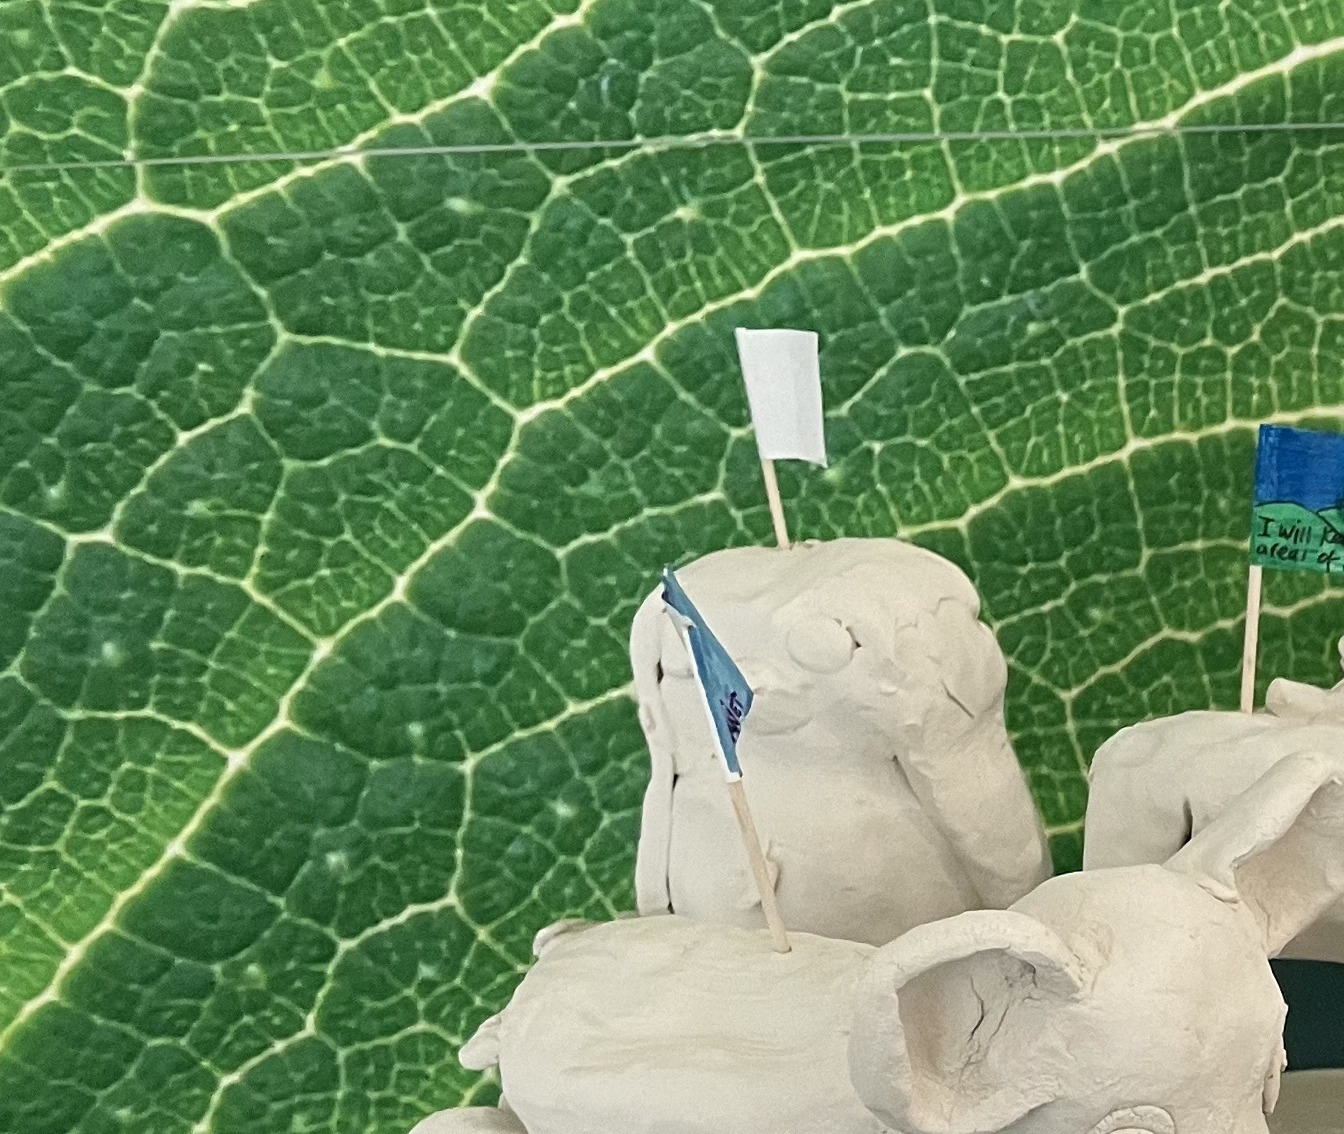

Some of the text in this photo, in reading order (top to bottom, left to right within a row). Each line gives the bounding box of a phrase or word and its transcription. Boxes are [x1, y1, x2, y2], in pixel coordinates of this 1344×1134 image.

[1257, 516, 1275, 537] I
[1278, 520, 1312, 545] will
[1256, 543, 1308, 562] areas
[1317, 550, 1340, 572] of
